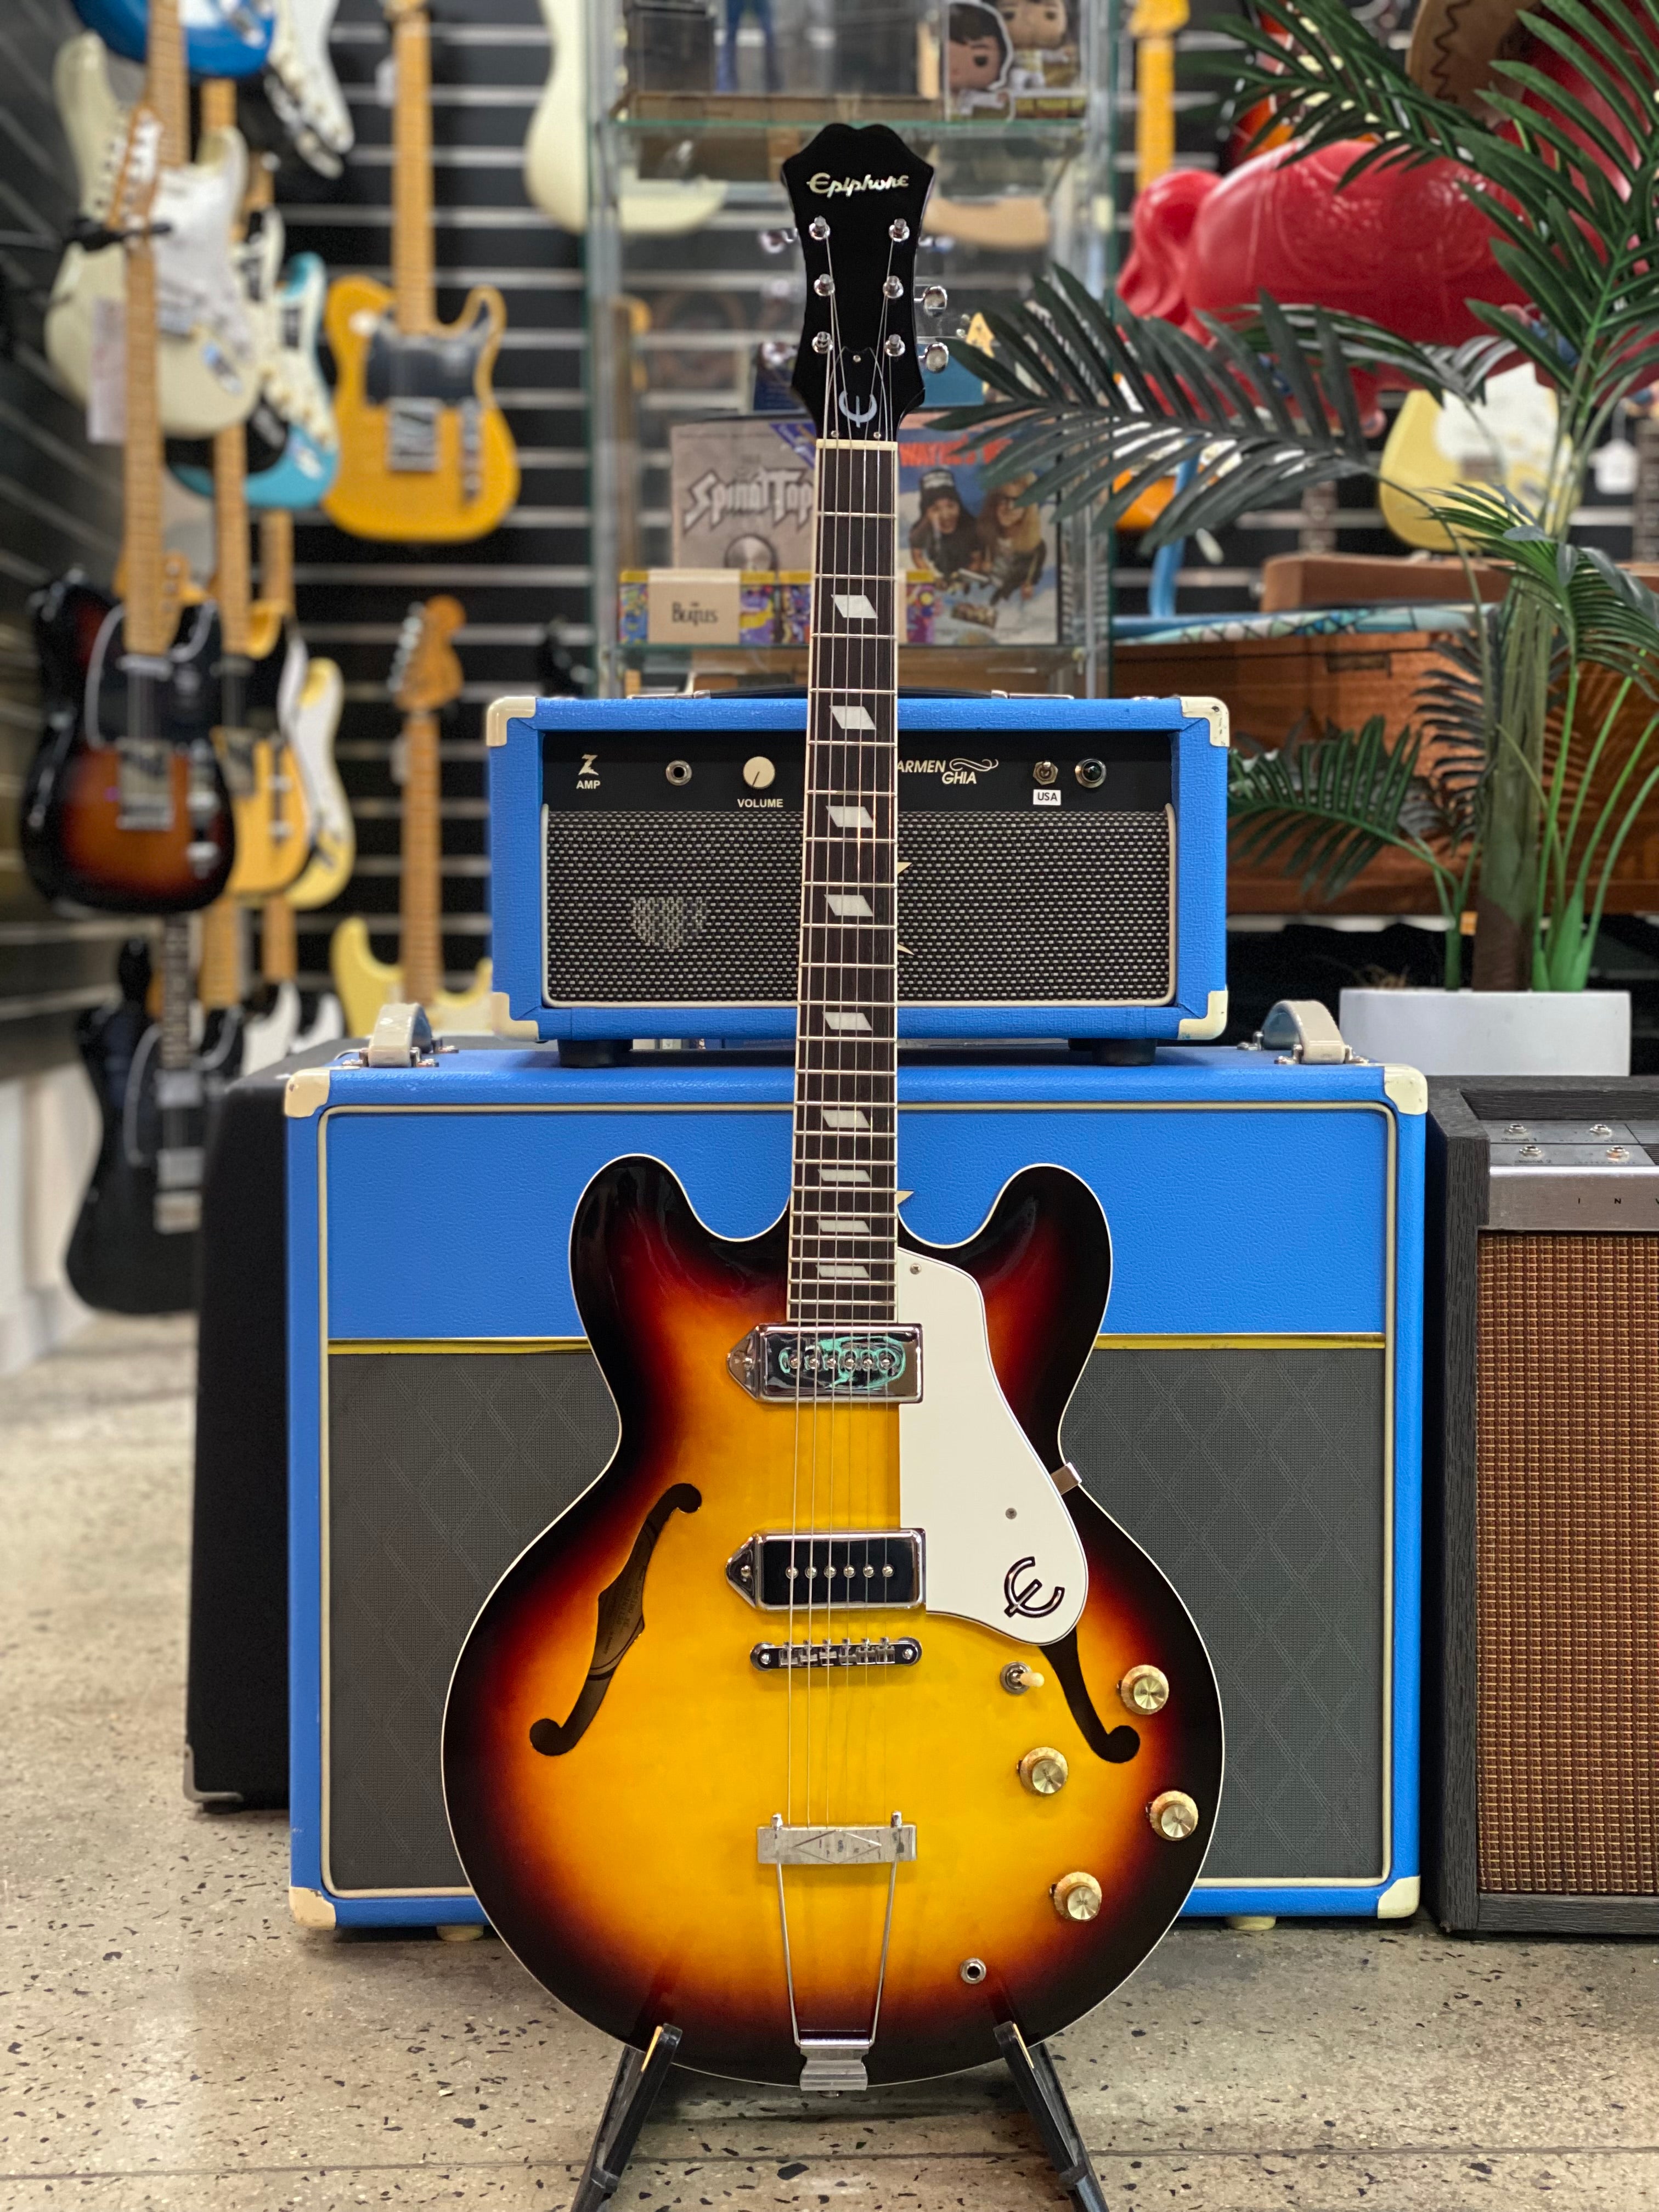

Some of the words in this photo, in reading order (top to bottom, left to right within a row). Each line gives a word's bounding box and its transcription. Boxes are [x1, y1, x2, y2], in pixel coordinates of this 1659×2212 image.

[806, 172, 909, 198] Epiphone
[898, 760, 946, 772] ARMEN
[942, 771, 977, 785] GHIA
[576, 780, 601, 789] AMP
[1037, 792, 1058, 802] USA
[737, 798, 784, 808] VOLUME
